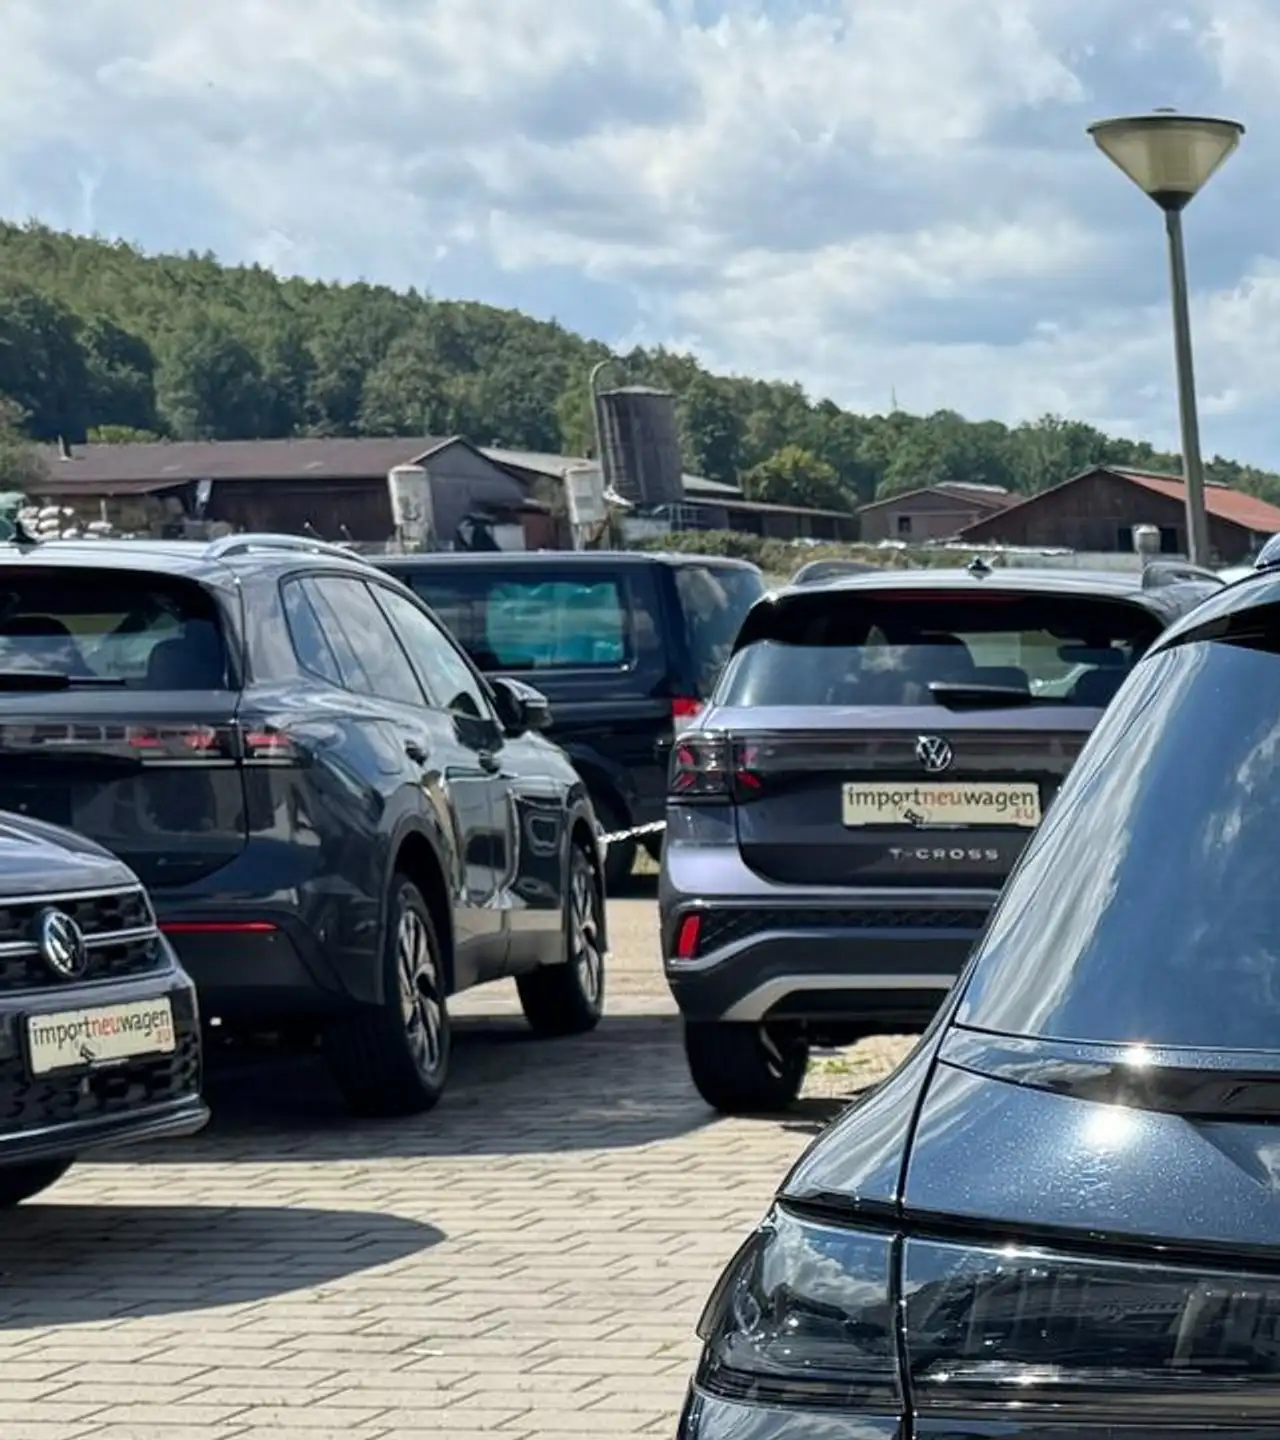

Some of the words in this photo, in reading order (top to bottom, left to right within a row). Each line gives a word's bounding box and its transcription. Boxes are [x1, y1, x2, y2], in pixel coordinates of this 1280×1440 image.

[848, 786, 1034, 812] importneuwagen
[889, 848, 998, 860] T-CROSS
[32, 1008, 170, 1050] importneuwagen
